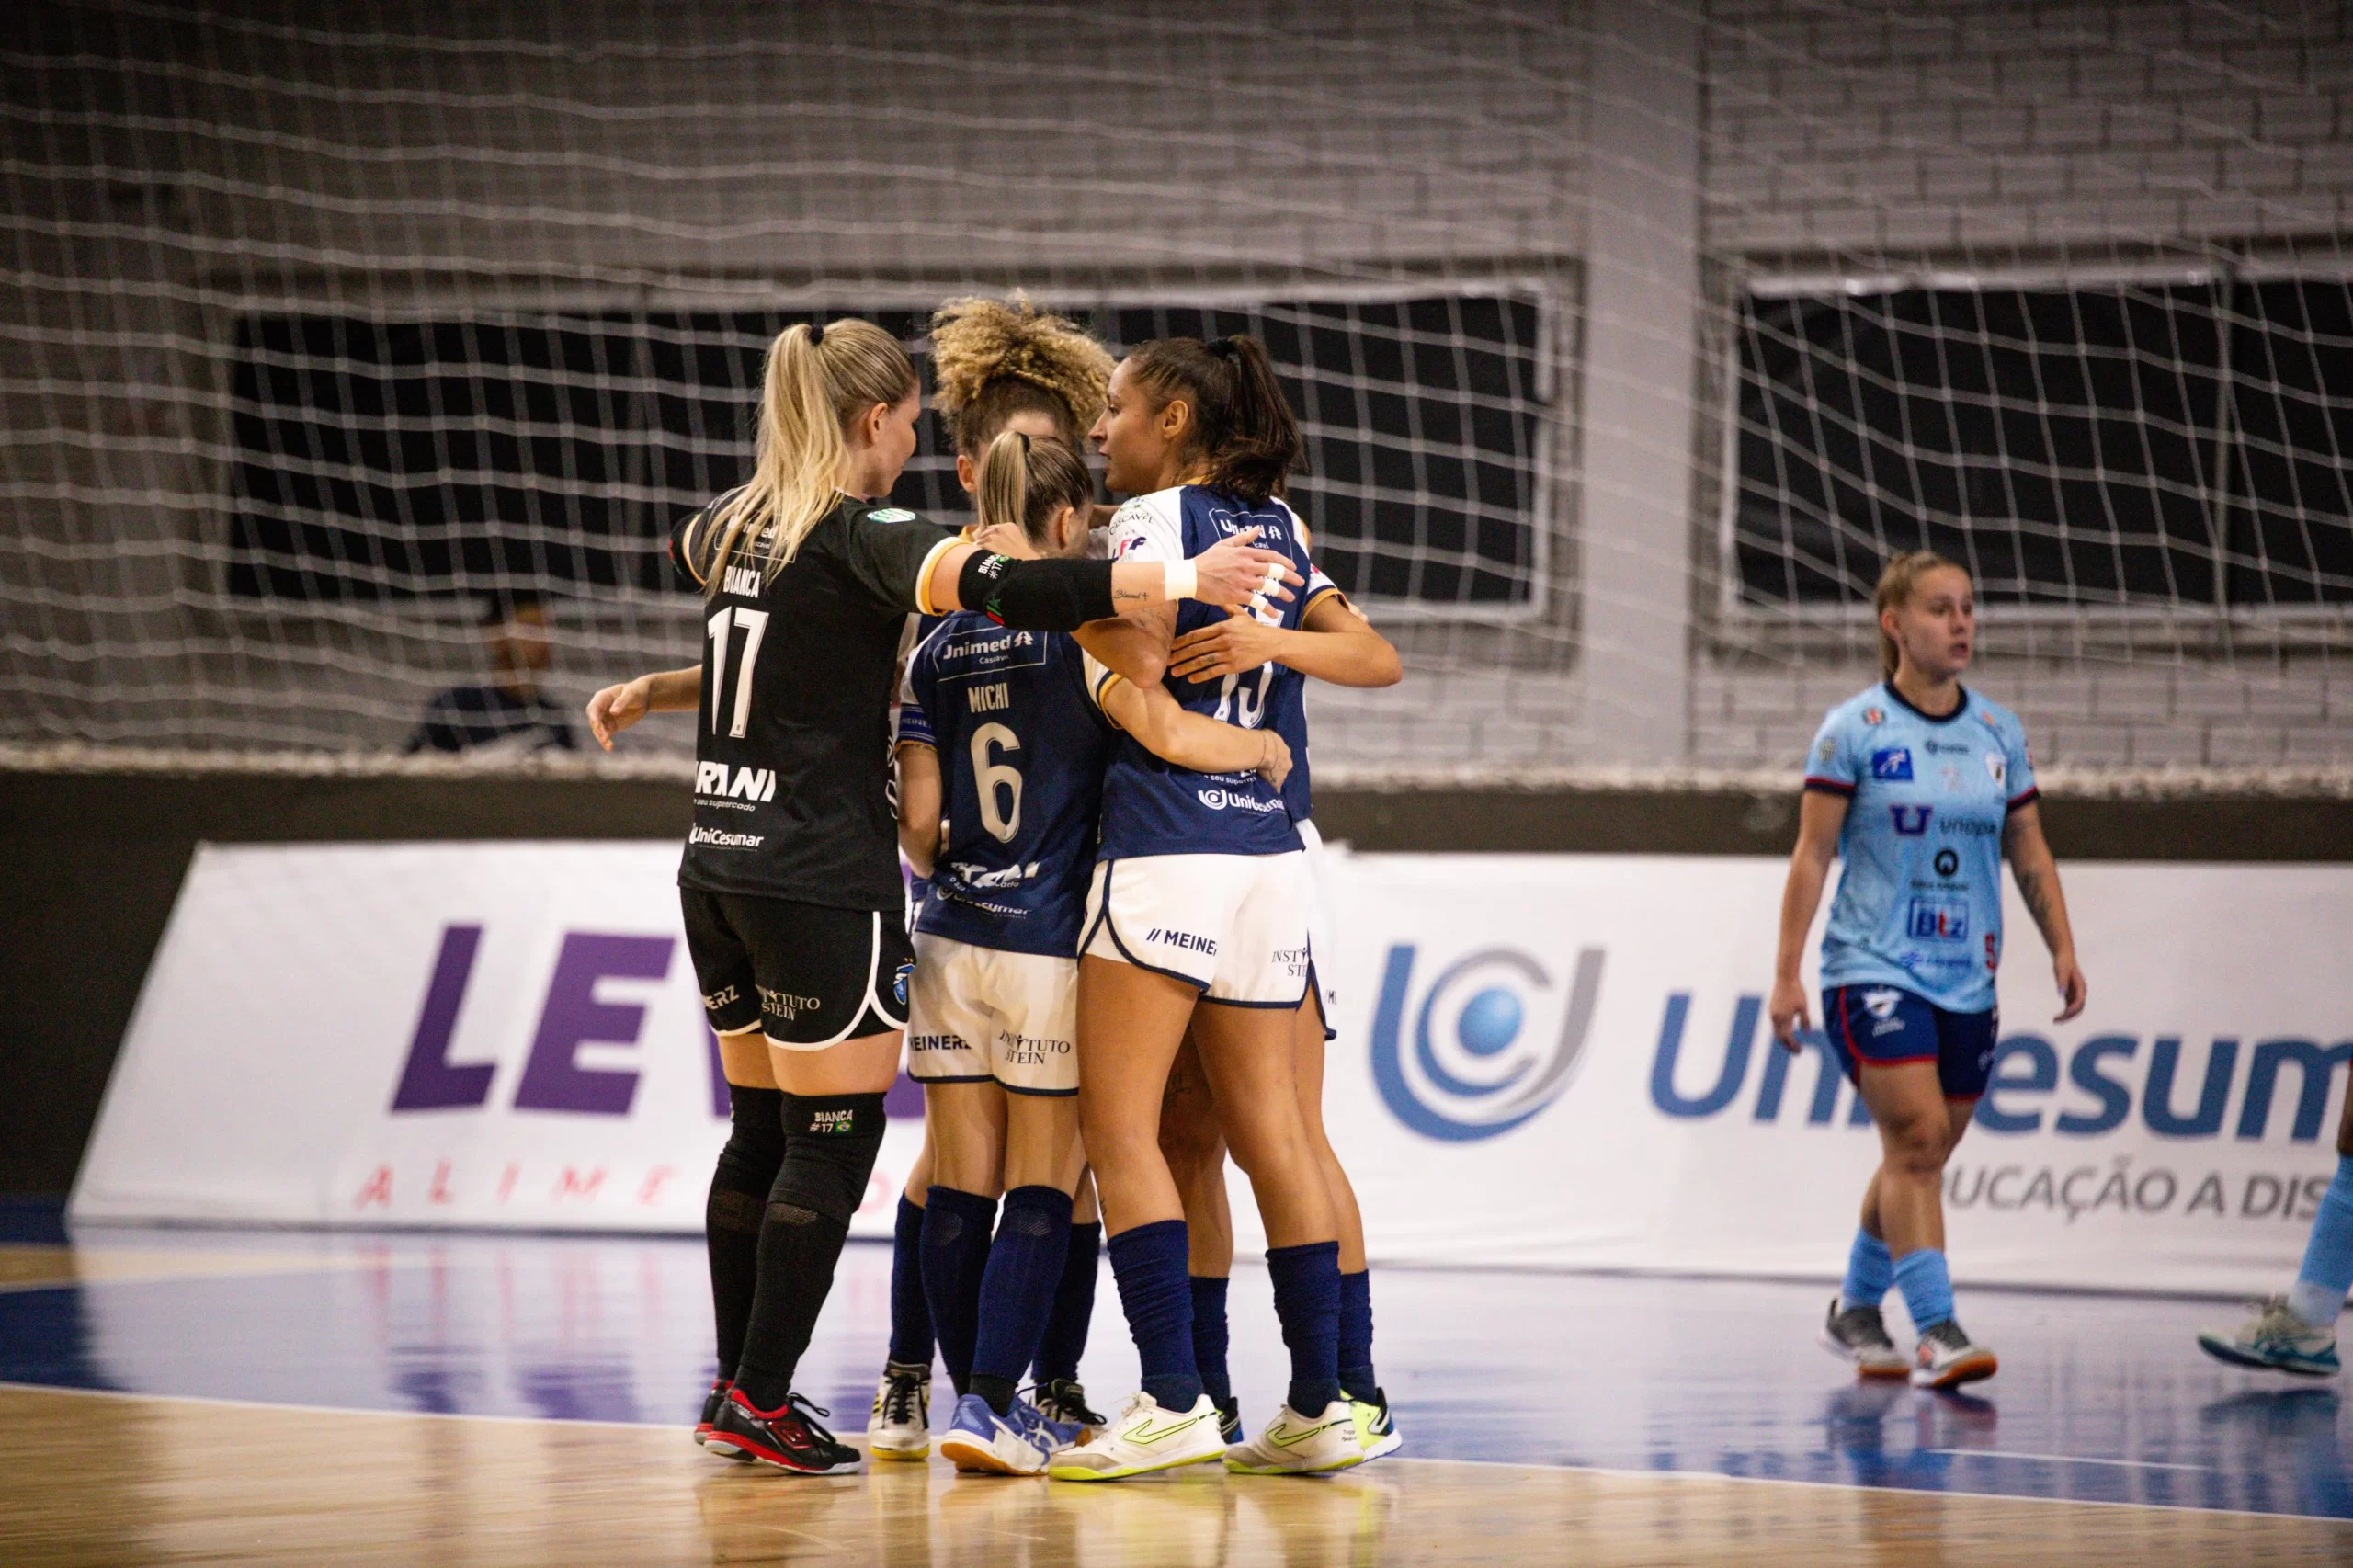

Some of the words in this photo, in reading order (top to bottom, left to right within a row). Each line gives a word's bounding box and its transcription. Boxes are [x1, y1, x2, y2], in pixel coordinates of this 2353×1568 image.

[722, 565, 761, 598] BIANCA
[708, 606, 769, 738] 17
[967, 682, 1010, 713] MICHI
[695, 760, 777, 803] RANI
[971, 722, 1024, 844] 6
[1164, 930, 1217, 957] MEINE
[1287, 964, 1307, 977] STE
[762, 1002, 795, 1021] STEIN
[809, 1122, 834, 1133] #17
[814, 1109, 853, 1122] BIANCA
[1942, 1154, 2178, 1224] UCAÇÃO
[2184, 1169, 2228, 1218] A
[2240, 1174, 2335, 1221] DIS
